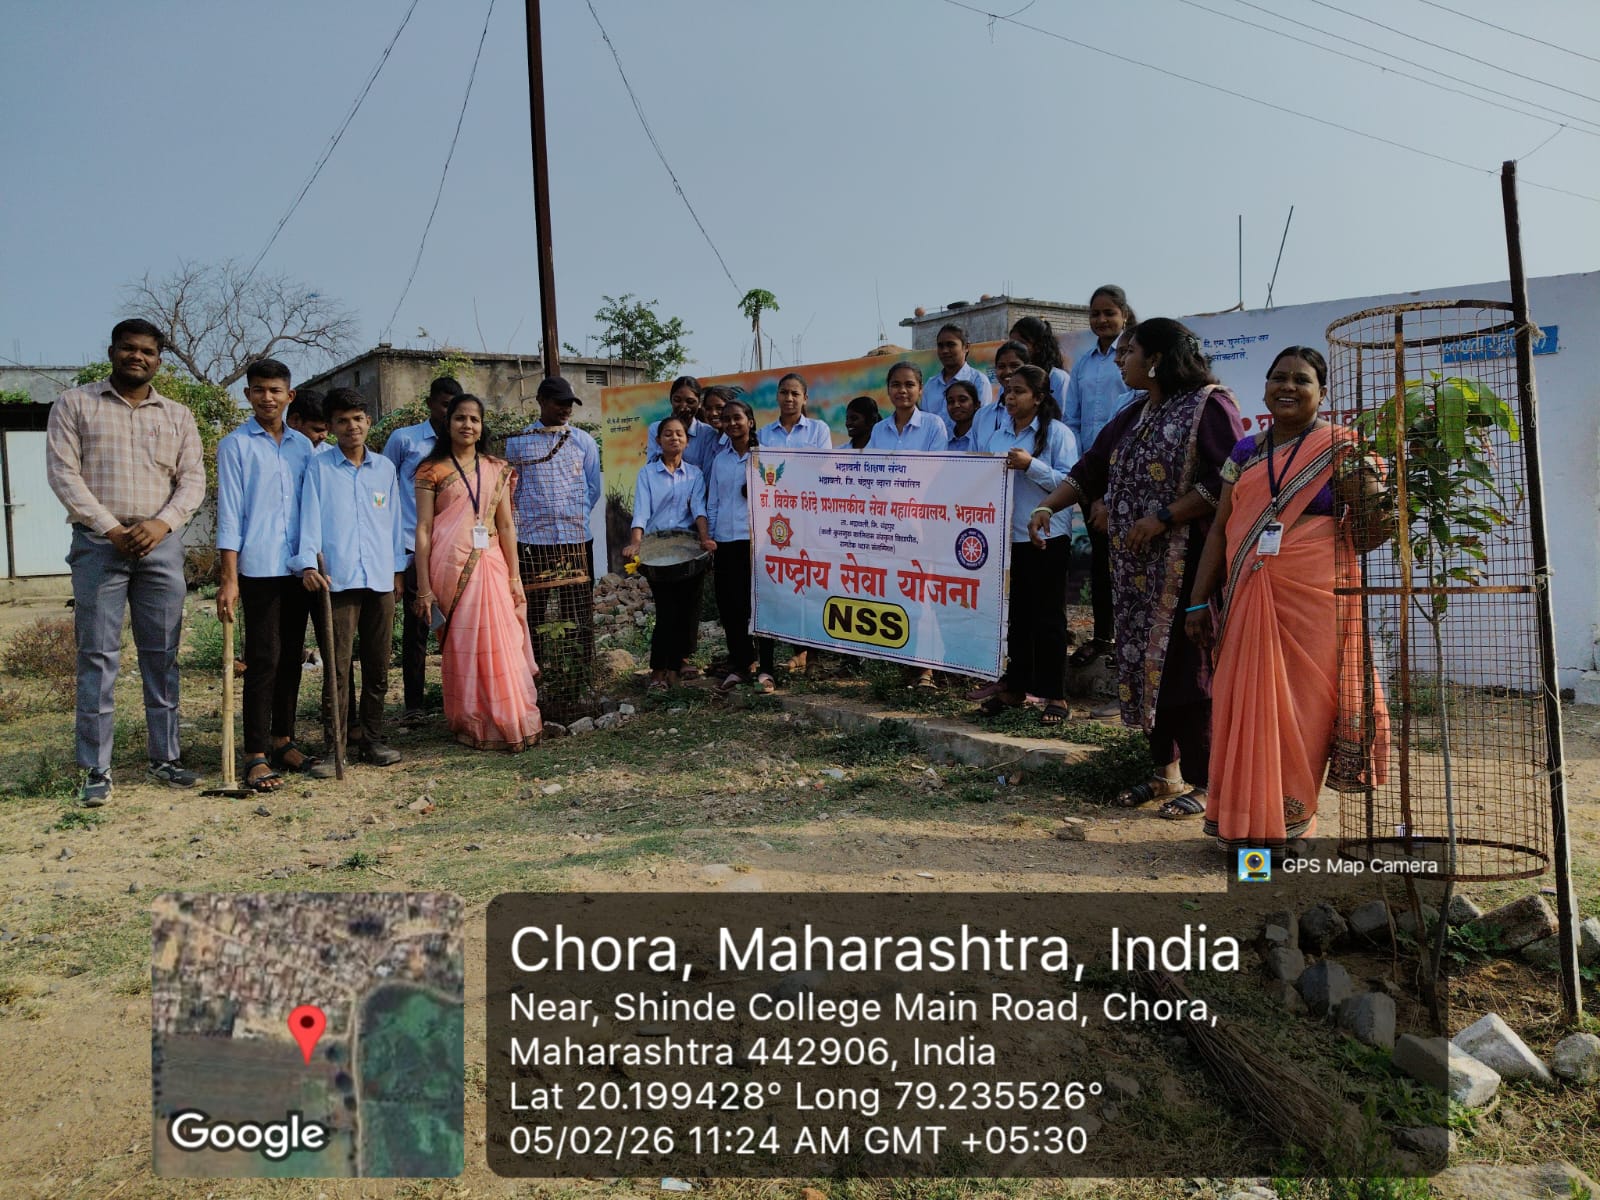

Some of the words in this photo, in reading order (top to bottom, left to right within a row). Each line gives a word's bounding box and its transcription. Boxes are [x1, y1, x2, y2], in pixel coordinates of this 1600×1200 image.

[774, 489, 798, 510] विवेक
[820, 494, 866, 515] प्रशासकीय
[869, 495, 888, 516] सेवा
[955, 502, 996, 526] भद्रावती
[765, 549, 831, 595] राष्ट्रीय
[840, 553, 888, 598] सेवा
[897, 560, 980, 610] योजना
[828, 603, 903, 641] NSS
